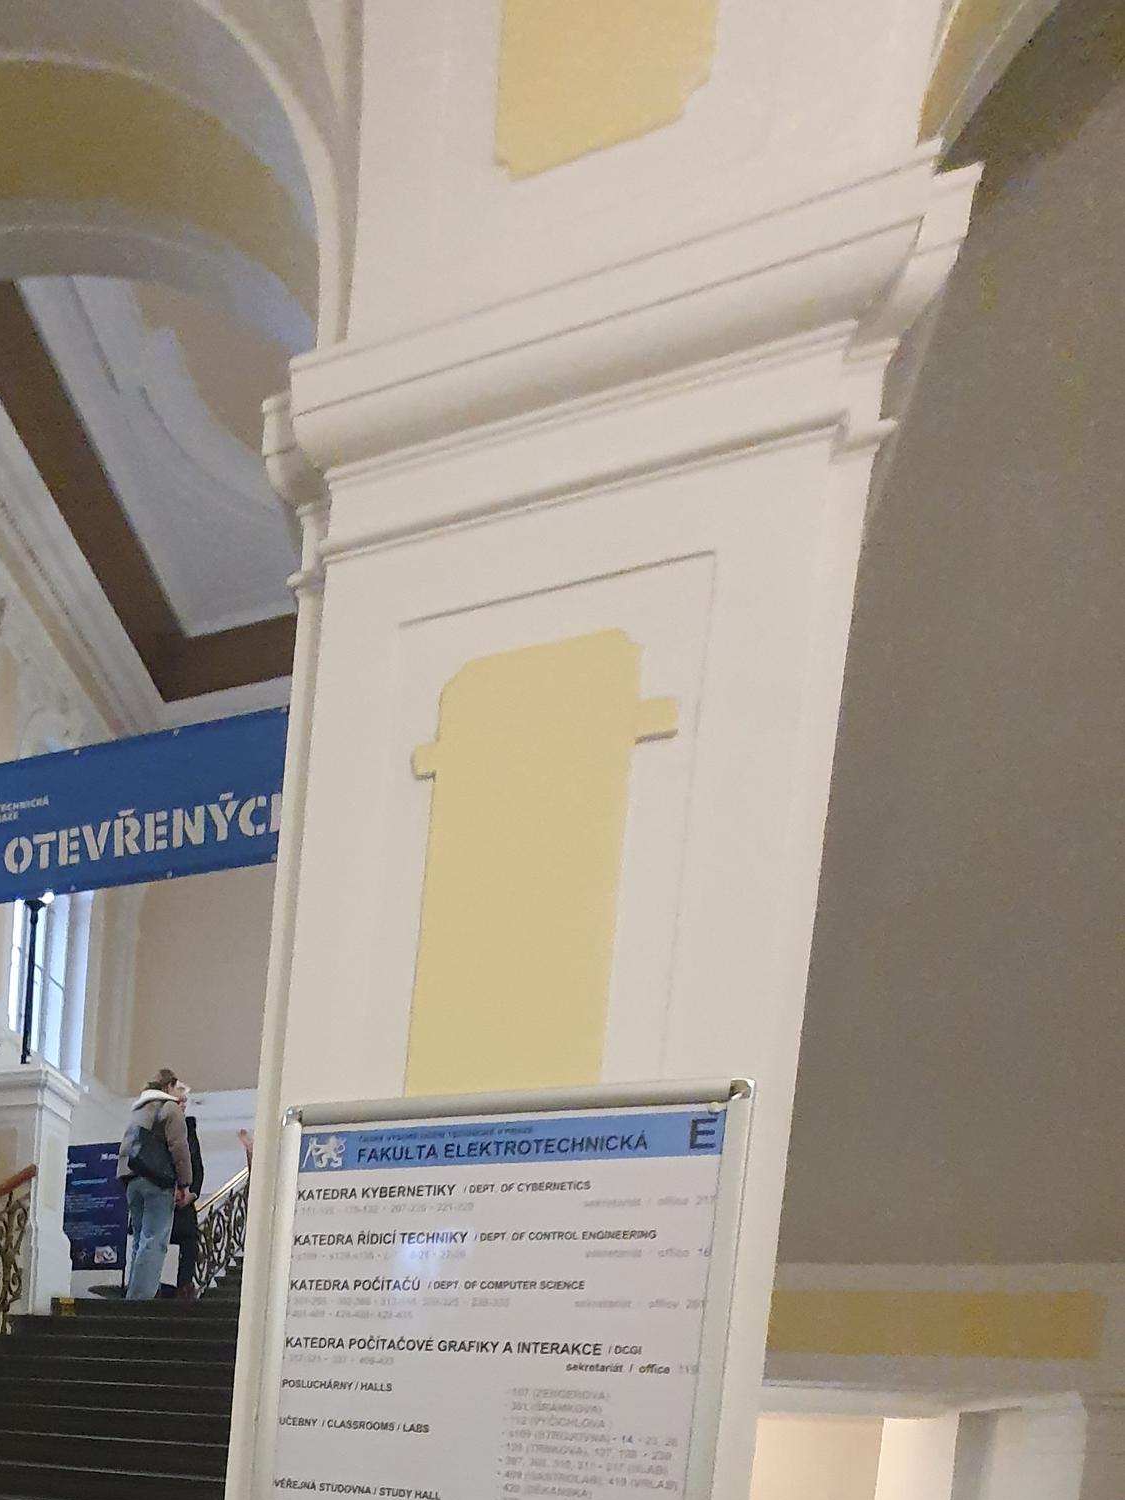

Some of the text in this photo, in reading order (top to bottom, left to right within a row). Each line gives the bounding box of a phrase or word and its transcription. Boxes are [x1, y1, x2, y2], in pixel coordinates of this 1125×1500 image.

[690, 1118, 718, 1149] E
[357, 1143, 438, 1163] FAKULTA
[444, 1129, 648, 1159] ELEKTROTECHNICKÁ
[298, 1187, 357, 1201] KATEDRA
[361, 1184, 456, 1199] KYBERNETIKY
[500, 1183, 514, 1192] OF
[517, 1181, 591, 1192] CYBERNETICS
[294, 1233, 353, 1246] KATEDRA
[399, 1231, 468, 1245] TECHNIKY
[511, 1231, 524, 1241] OF
[528, 1231, 578, 1241] CONTROL
[582, 1229, 657, 1241] ENGINEERING
[290, 1279, 350, 1291] KATEDRA
[464, 1280, 478, 1289] OF
[480, 1280, 537, 1290] COMPUTER
[539, 1280, 585, 1290] SCIENCE
[285, 1336, 345, 1349] KATEDRA
[348, 1335, 434, 1351] POČÍTAČOVÉ
[437, 1339, 499, 1354] GRAFIKY
[503, 1342, 513, 1354] A
[517, 1342, 602, 1355] INTERAKCE
[639, 1363, 670, 1374] office
[282, 1378, 353, 1391] POSLUCHÁRNY
[360, 1382, 393, 1392] HALLS
[279, 1416, 318, 1427] UČEBNY
[327, 1419, 395, 1431] CLASSROOMS
[403, 1424, 429, 1433] LABS
[319, 1482, 371, 1495] STUDOVNA
[379, 1487, 413, 1499] STUDY
[415, 1490, 441, 1500] HALL
